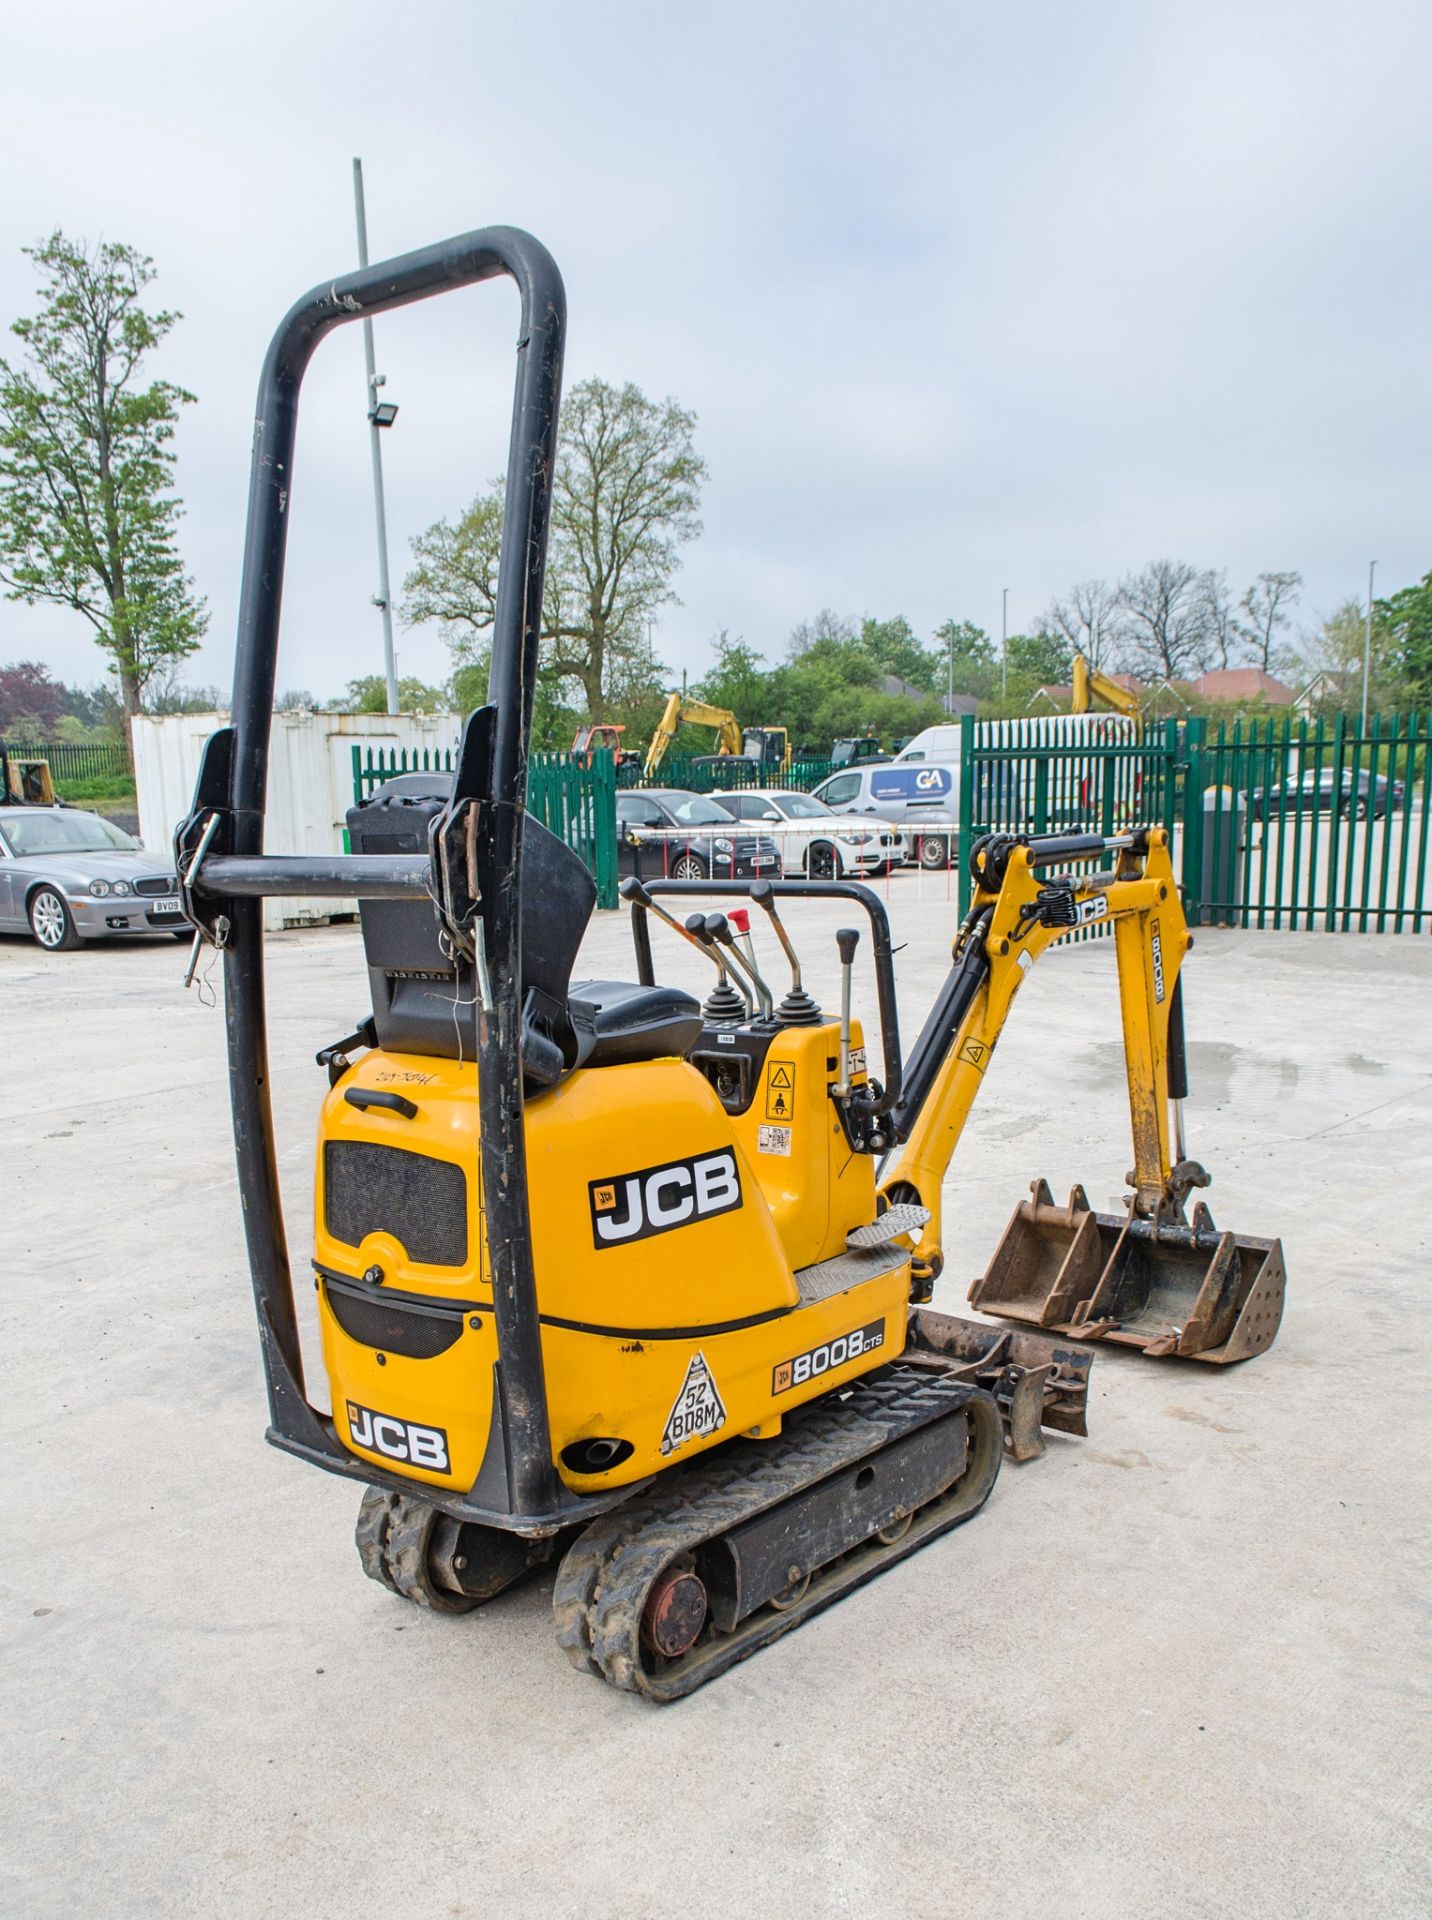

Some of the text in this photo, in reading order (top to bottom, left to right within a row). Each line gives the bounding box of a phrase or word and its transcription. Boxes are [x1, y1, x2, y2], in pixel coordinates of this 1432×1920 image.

[916, 769, 944, 789] GA
[157, 901, 179, 911] BV09
[1152, 936, 1164, 996] 8008
[597, 1154, 739, 1240] JCB
[686, 1382, 707, 1410] 52
[672, 1401, 715, 1439] BD8M
[351, 1410, 447, 1469] JCB
